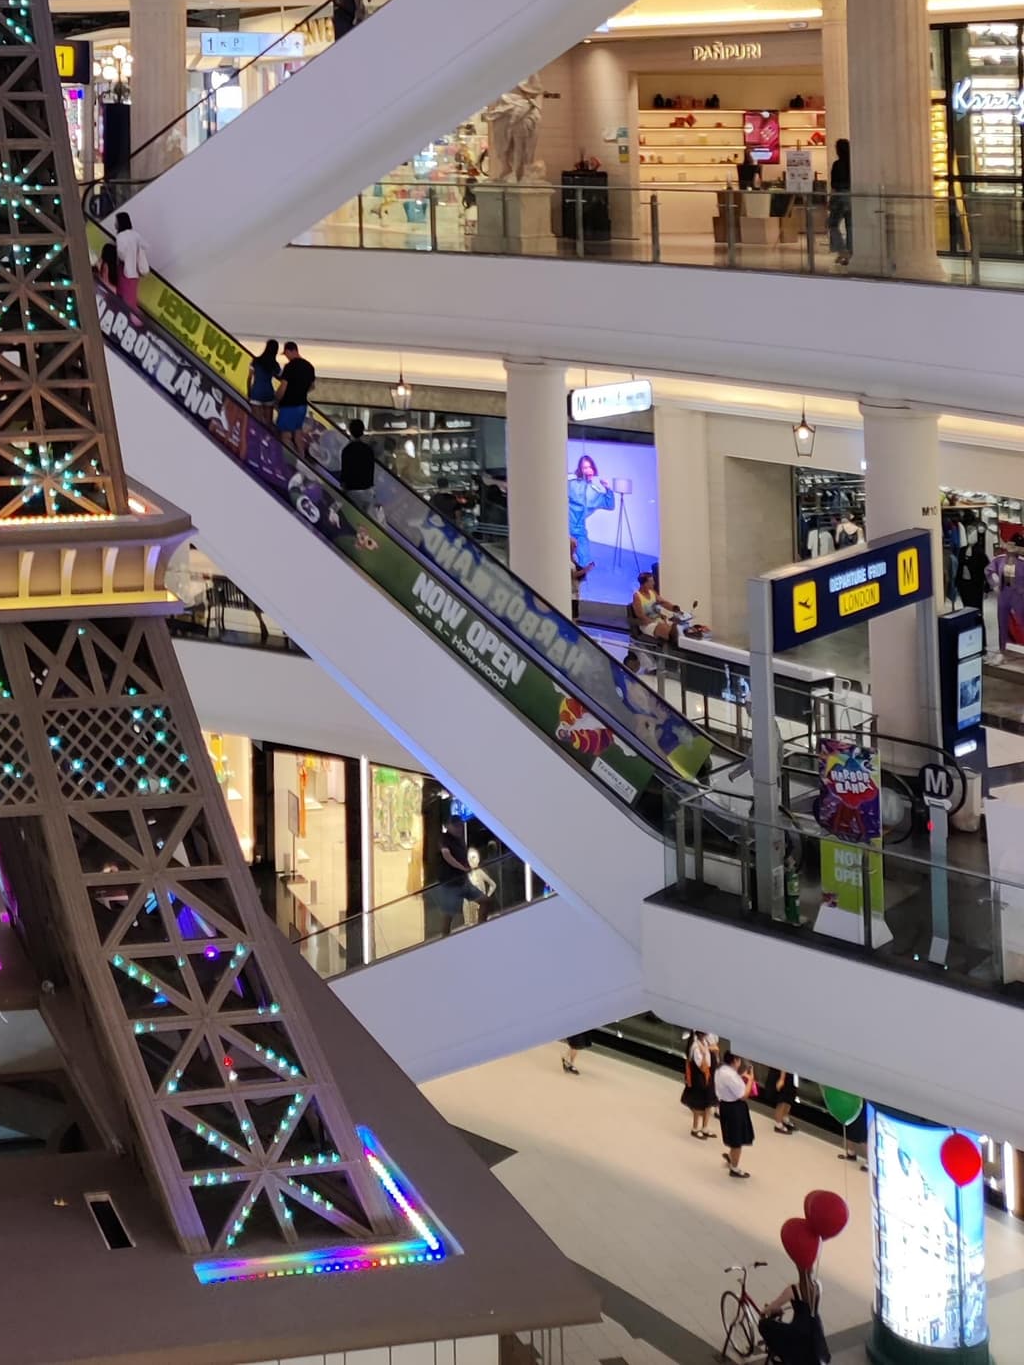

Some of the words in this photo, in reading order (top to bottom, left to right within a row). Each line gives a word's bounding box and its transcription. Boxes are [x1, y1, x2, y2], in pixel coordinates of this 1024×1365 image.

[59, 52, 66, 71] 1
[829, 567, 867, 594] DEPARTURE
[867, 561, 887, 580] FROM
[902, 557, 915, 587] M
[843, 588, 877, 613] LONDON
[411, 570, 468, 630] NOW
[465, 620, 527, 686] OPEN
[451, 635, 508, 690] Hollywood
[830, 769, 870, 784] HARBOR
[925, 767, 948, 795] M
